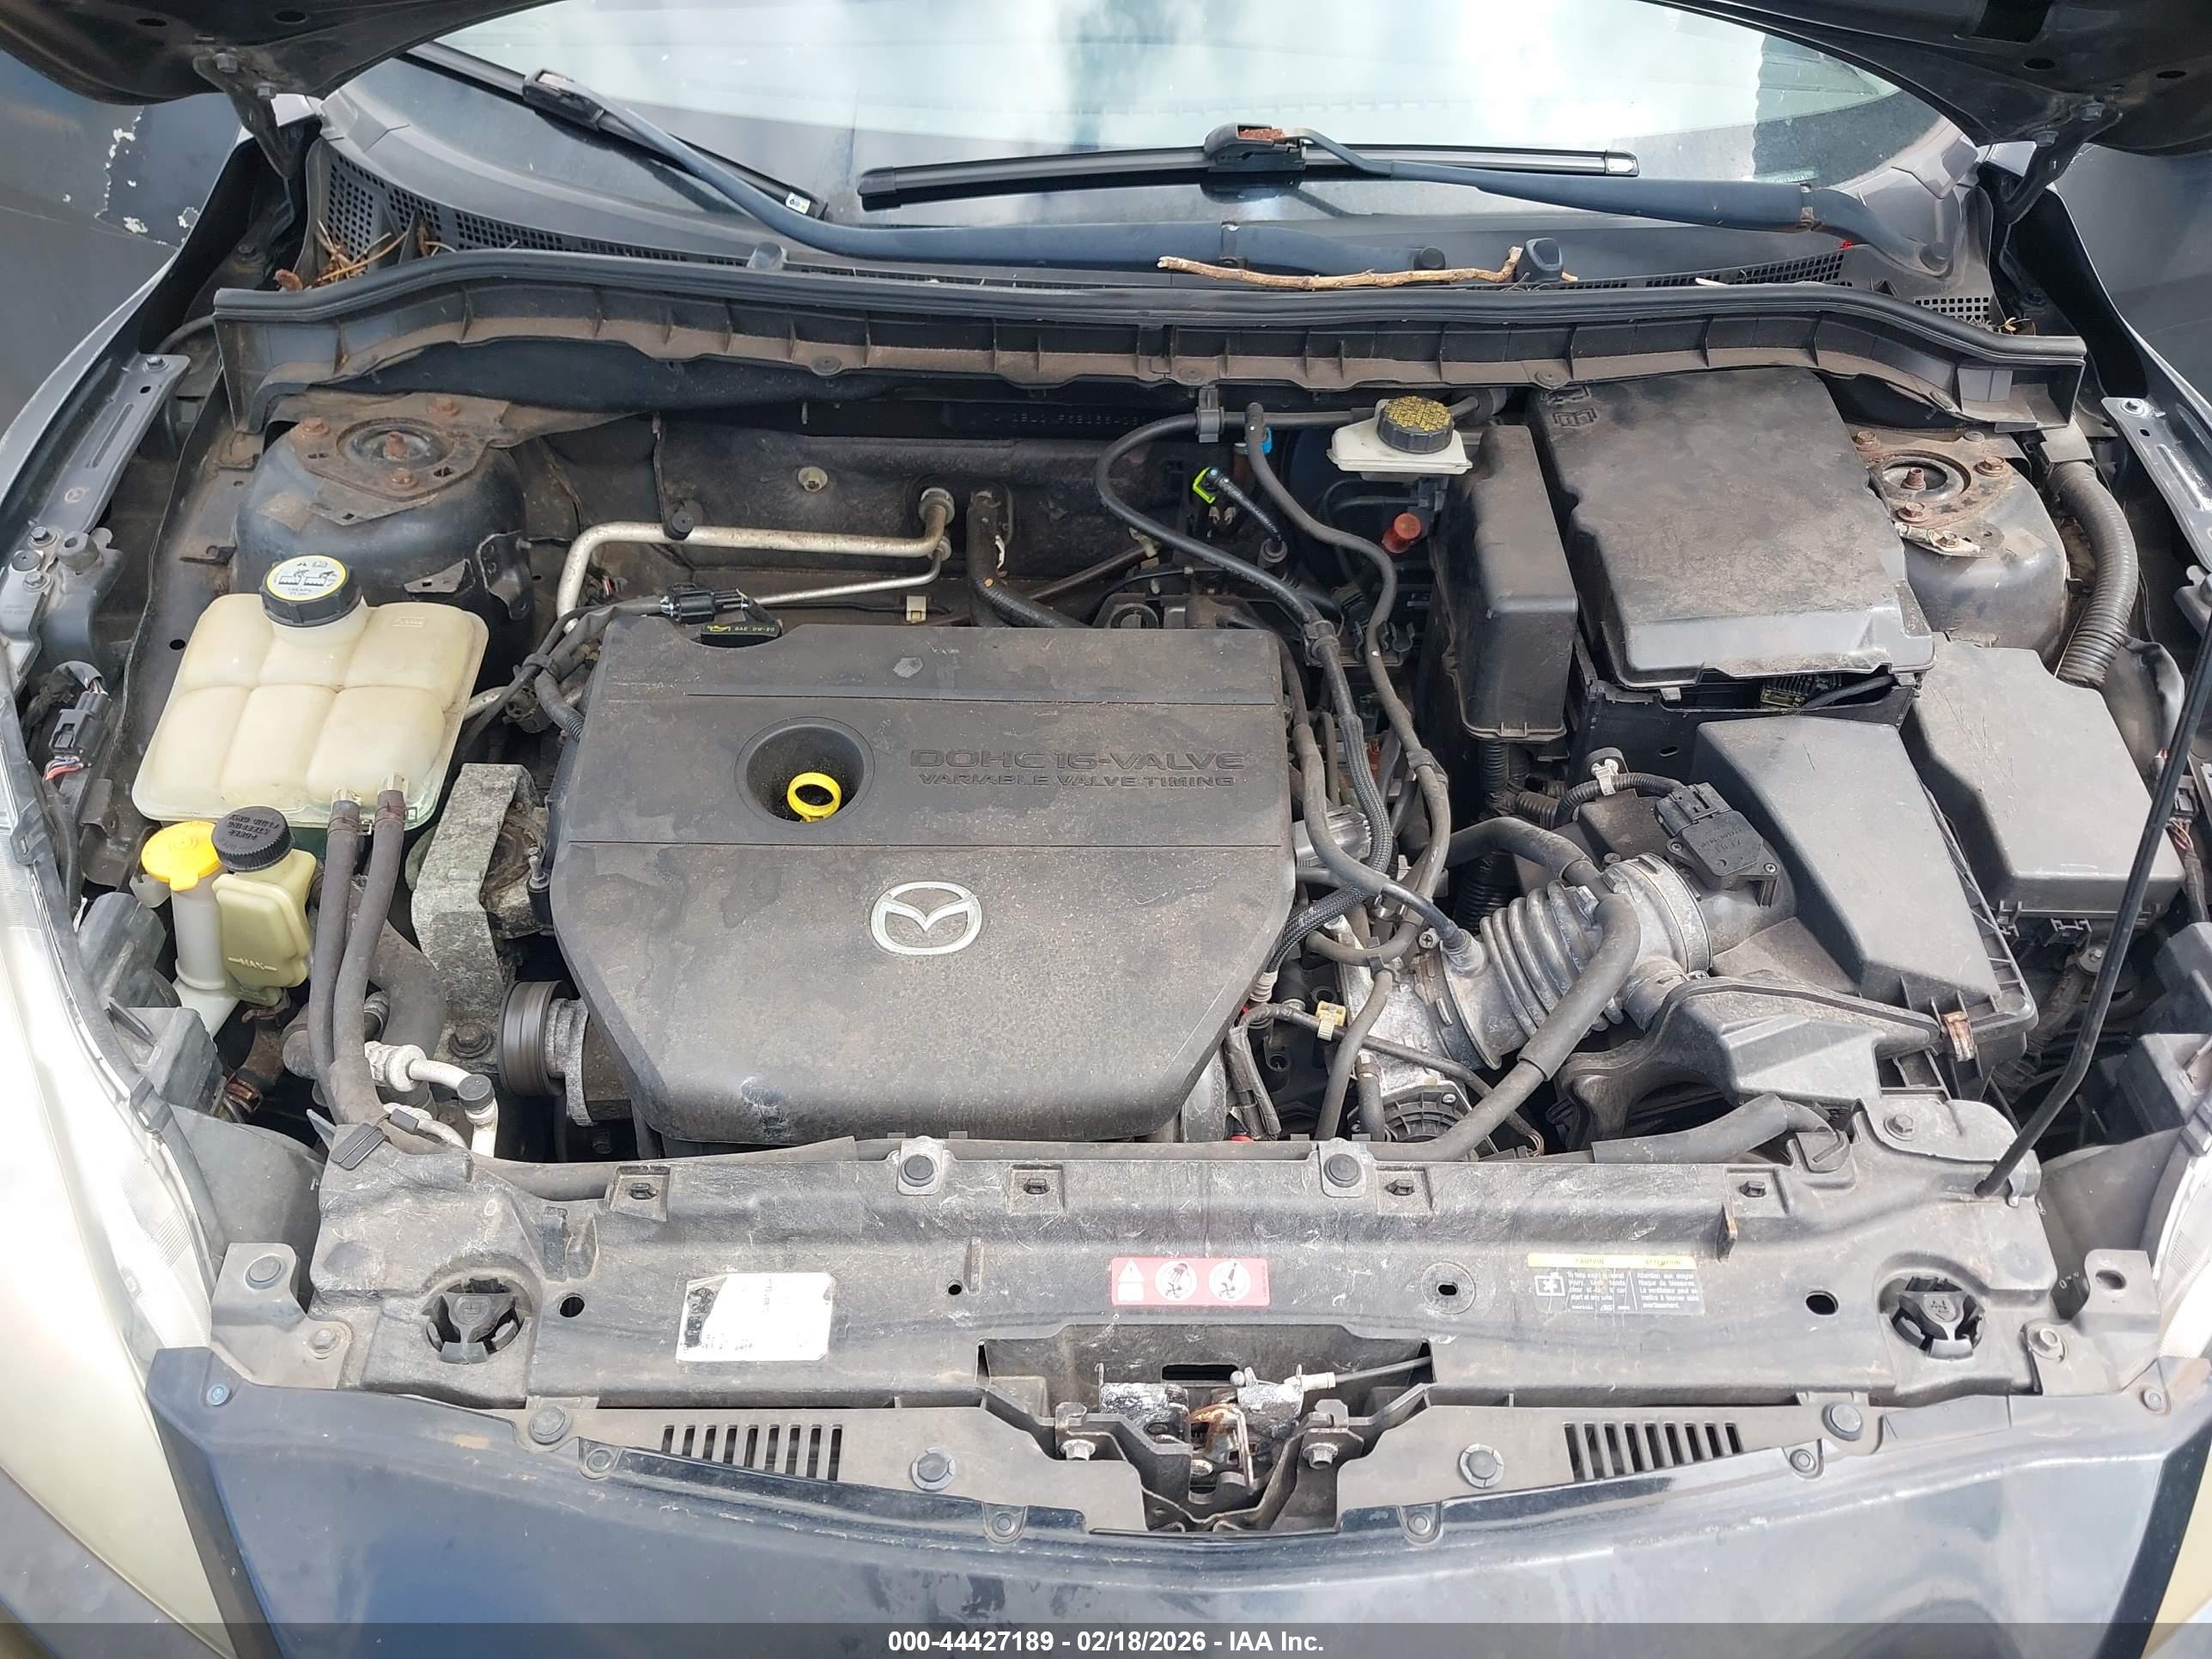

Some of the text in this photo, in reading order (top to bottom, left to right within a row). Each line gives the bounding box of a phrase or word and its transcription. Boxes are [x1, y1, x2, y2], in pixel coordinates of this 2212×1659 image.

[910, 749, 1245, 771] DOHC 16-VALVE
[919, 773, 1237, 788] VARIABLE VALVE TIMING
[240, 957, 265, 970] MAX
